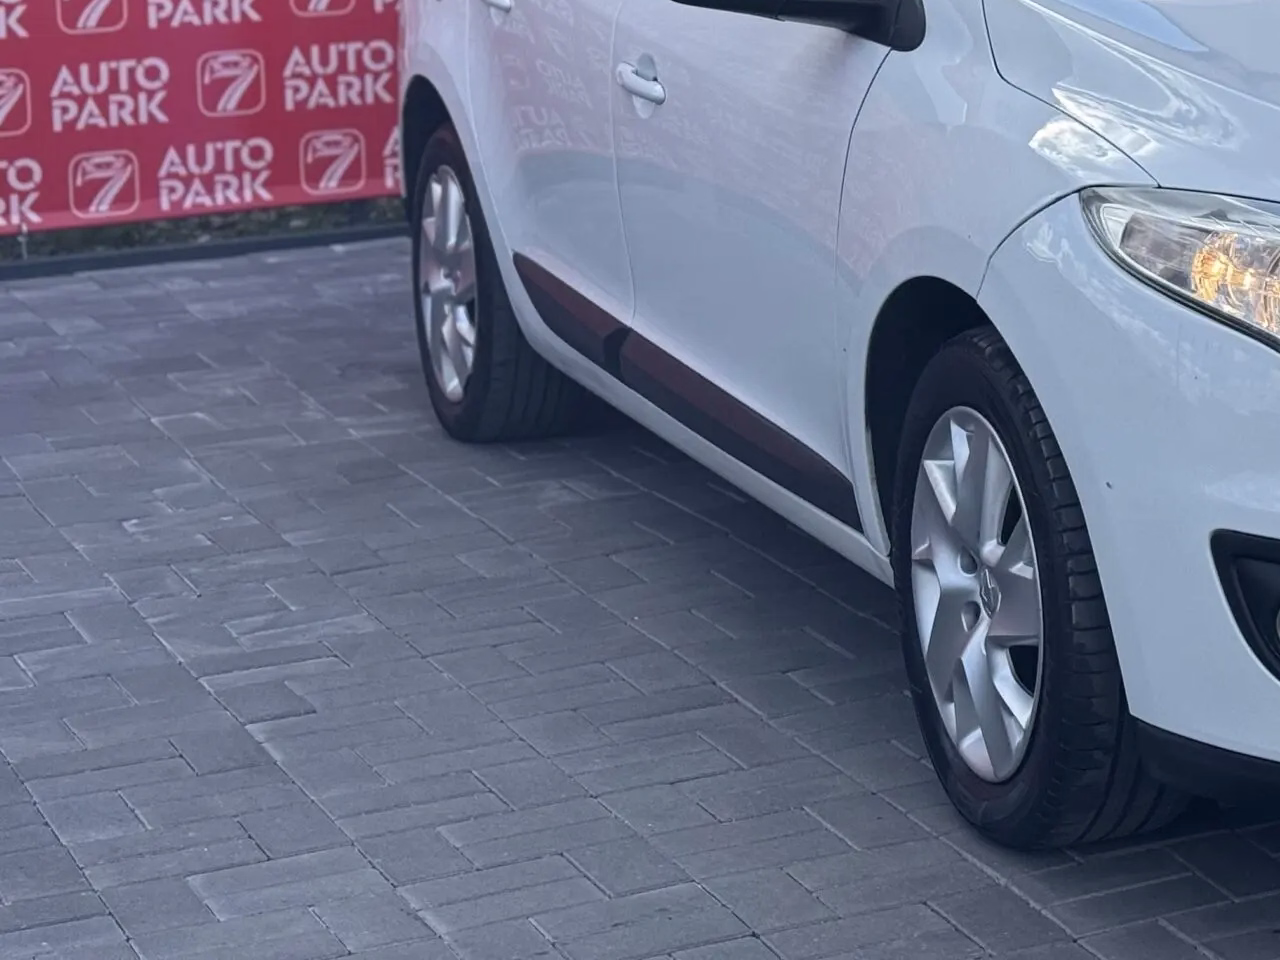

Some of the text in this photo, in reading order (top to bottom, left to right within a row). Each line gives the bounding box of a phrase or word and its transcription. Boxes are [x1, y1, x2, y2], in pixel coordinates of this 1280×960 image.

[50, 57, 169, 97] AUTO
[283, 40, 394, 76] AUTO
[52, 91, 169, 132] PARK
[284, 73, 393, 111] PARK
[158, 137, 273, 177] AUTO
[159, 170, 273, 211] PARK
